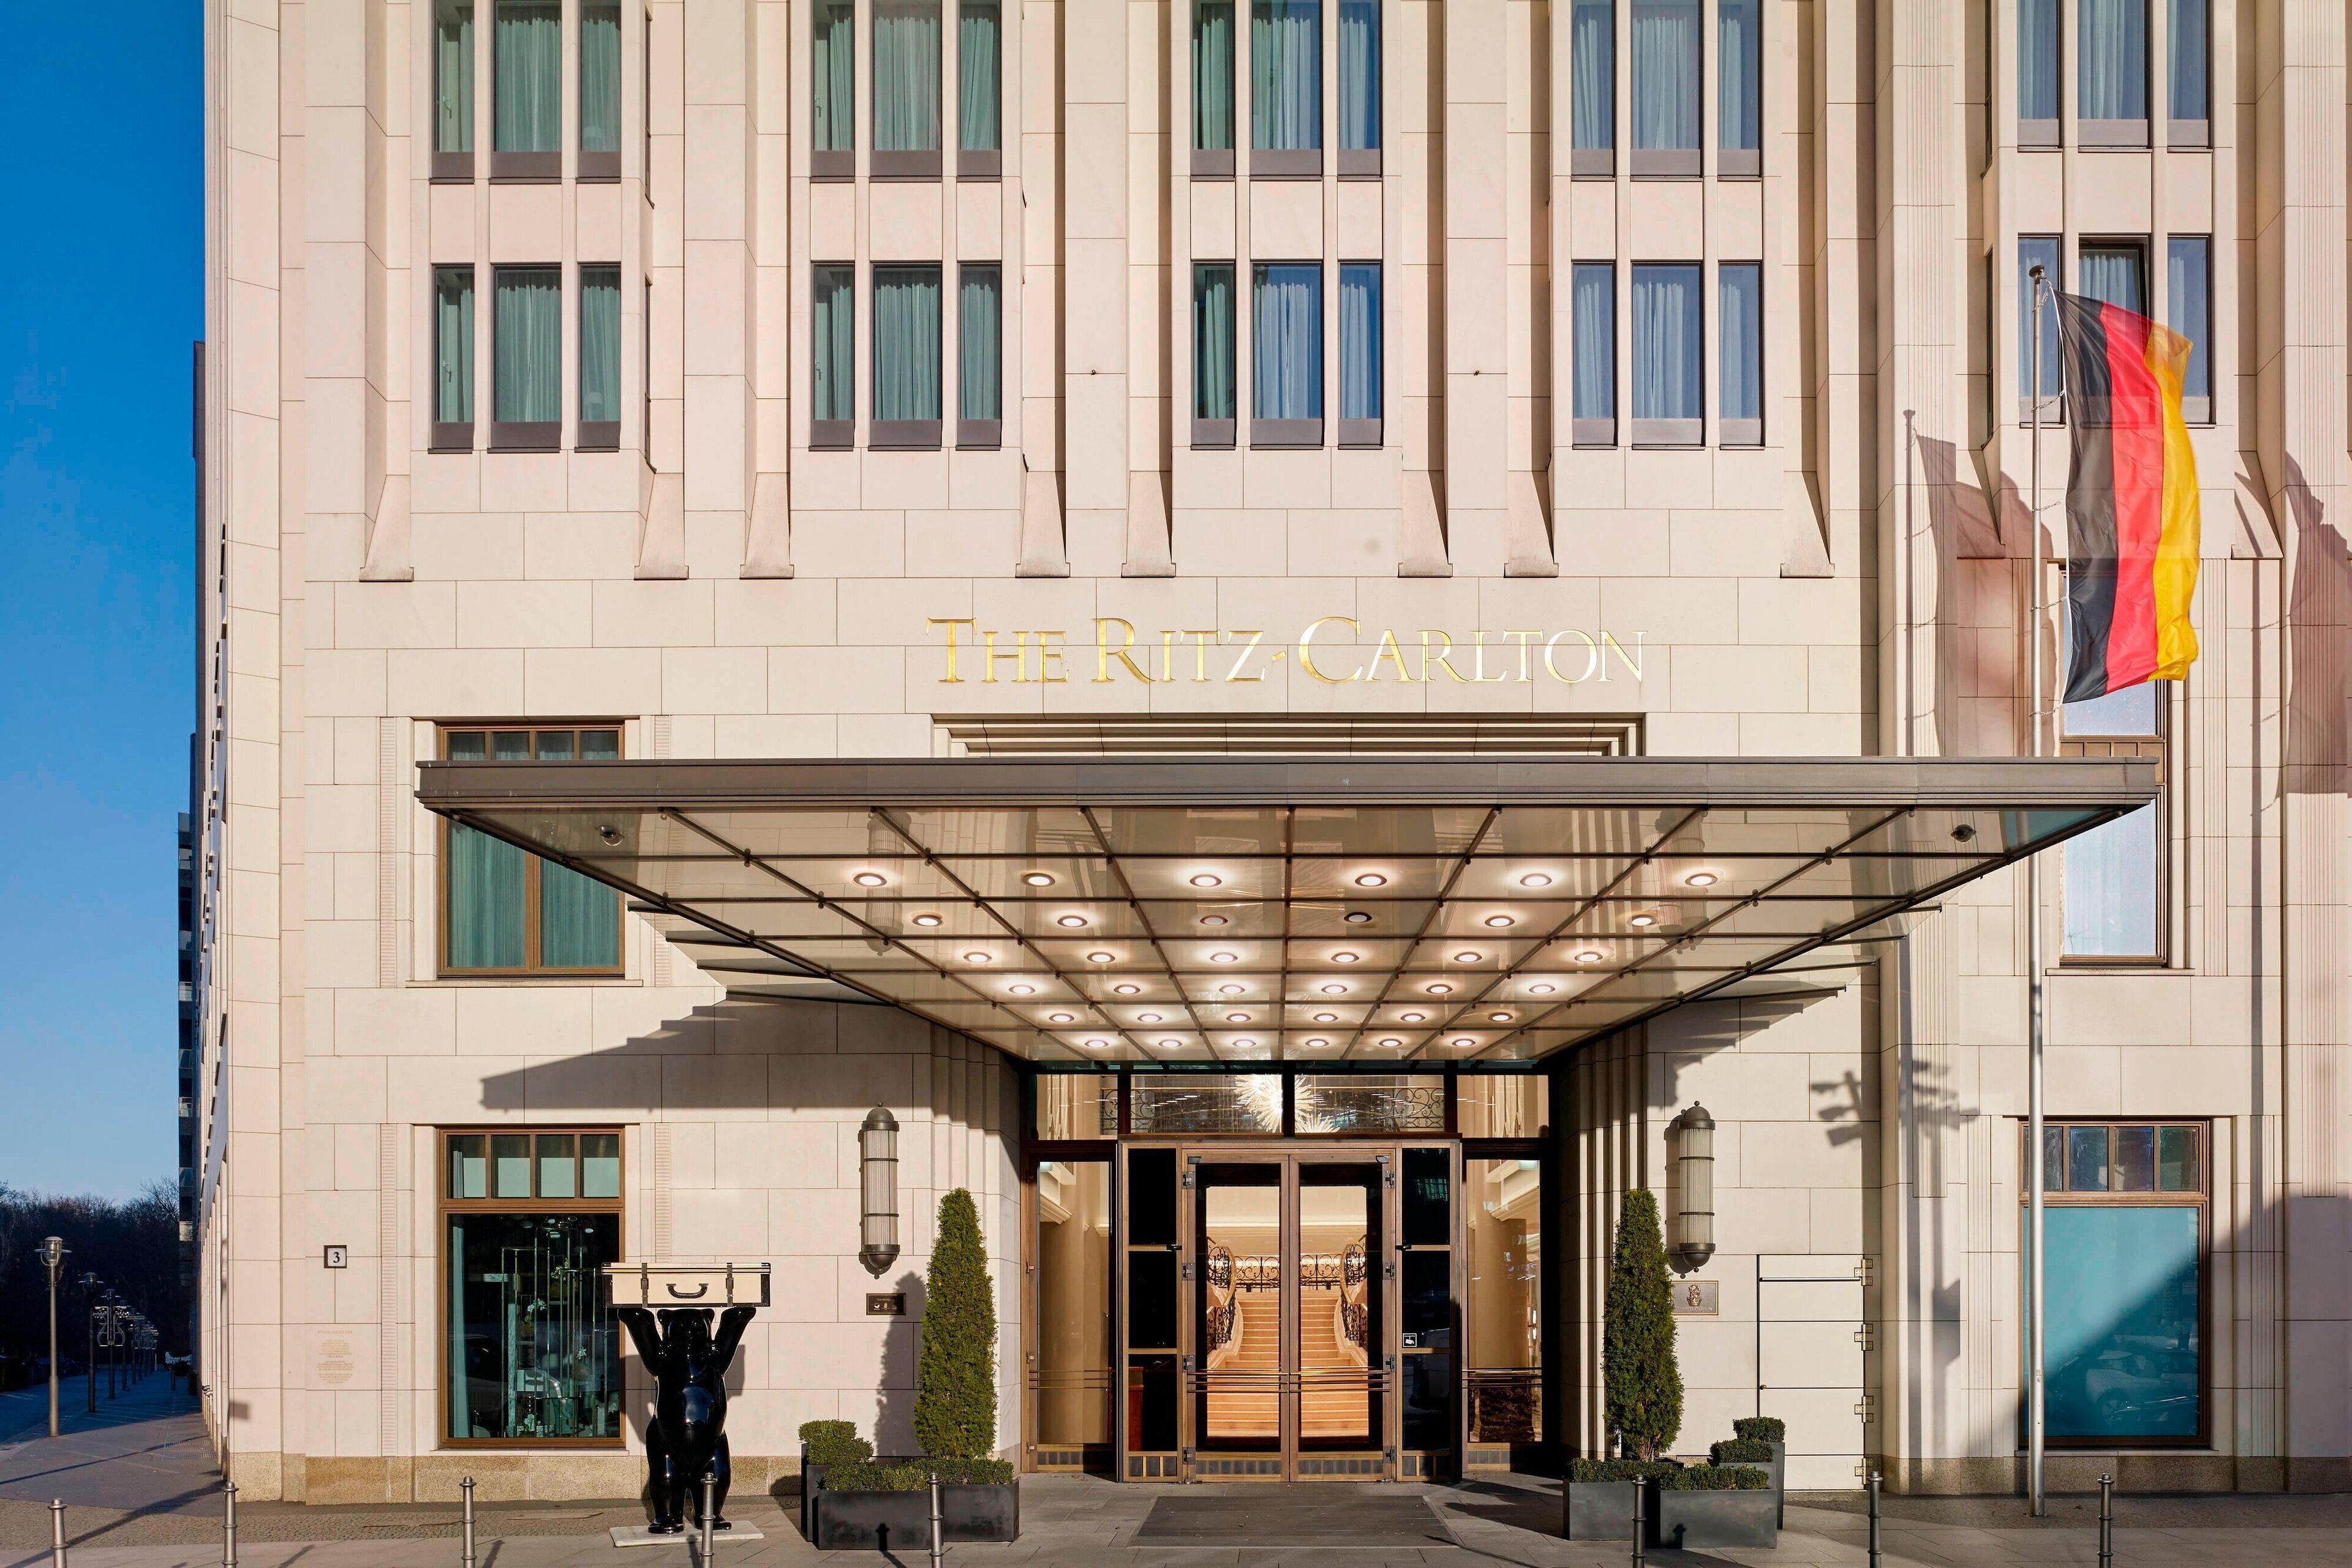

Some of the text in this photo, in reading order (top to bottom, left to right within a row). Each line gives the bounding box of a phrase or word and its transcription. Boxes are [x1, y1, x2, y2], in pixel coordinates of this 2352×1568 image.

[926, 617, 1648, 683] THE RITZ-CARLTON
[333, 1251, 340, 1263] 3
